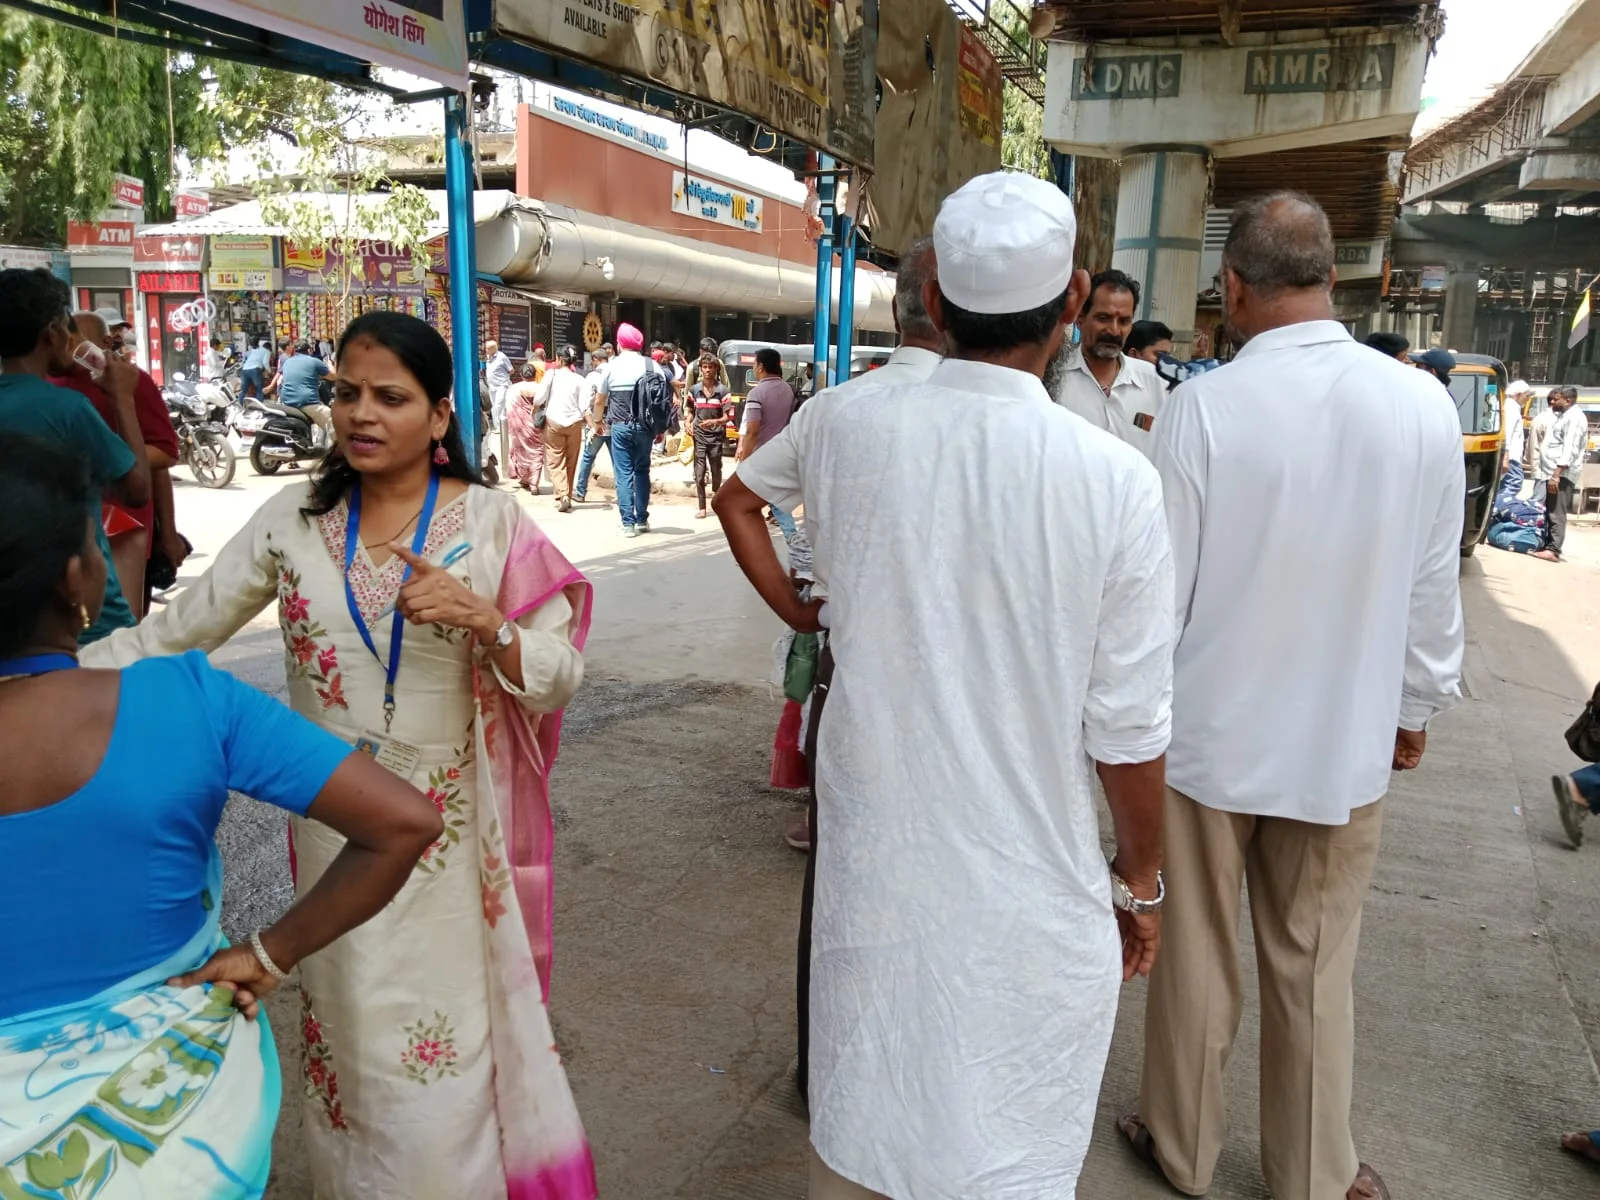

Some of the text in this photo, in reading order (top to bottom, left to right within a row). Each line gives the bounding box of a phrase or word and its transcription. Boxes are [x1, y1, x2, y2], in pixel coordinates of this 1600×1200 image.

[363, 1, 426, 46] योगेश सिंग
[564, 7, 607, 39] AVAILABLE
[1079, 60, 1176, 94] KDMC
[119, 186, 142, 201] ATM
[186, 201, 207, 213] ATM
[731, 194, 746, 221] 100
[98, 228, 132, 243] ATM
